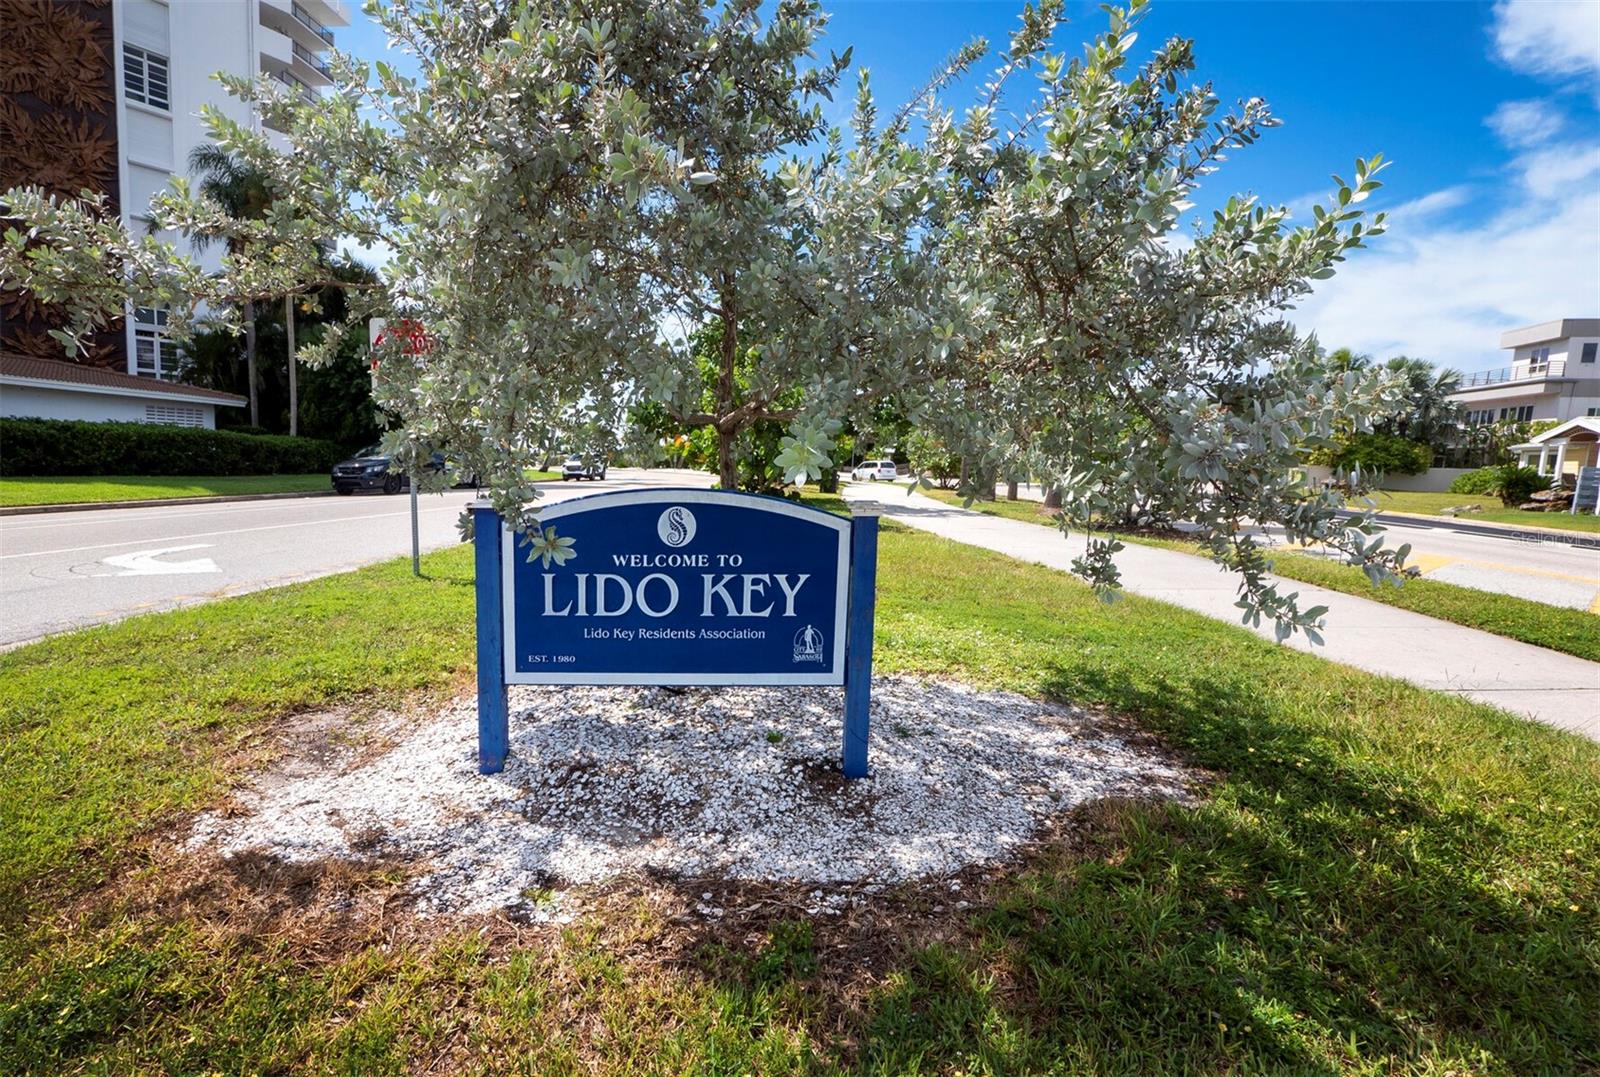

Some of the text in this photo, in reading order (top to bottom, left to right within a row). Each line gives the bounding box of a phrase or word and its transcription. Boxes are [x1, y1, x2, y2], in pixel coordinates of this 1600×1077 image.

[612, 554, 743, 568] WELCOME TO
[541, 573, 811, 617] LIDO KEY
[584, 628, 766, 642] Lido Key Residents Association
[528, 655, 576, 663] EST. 1980
